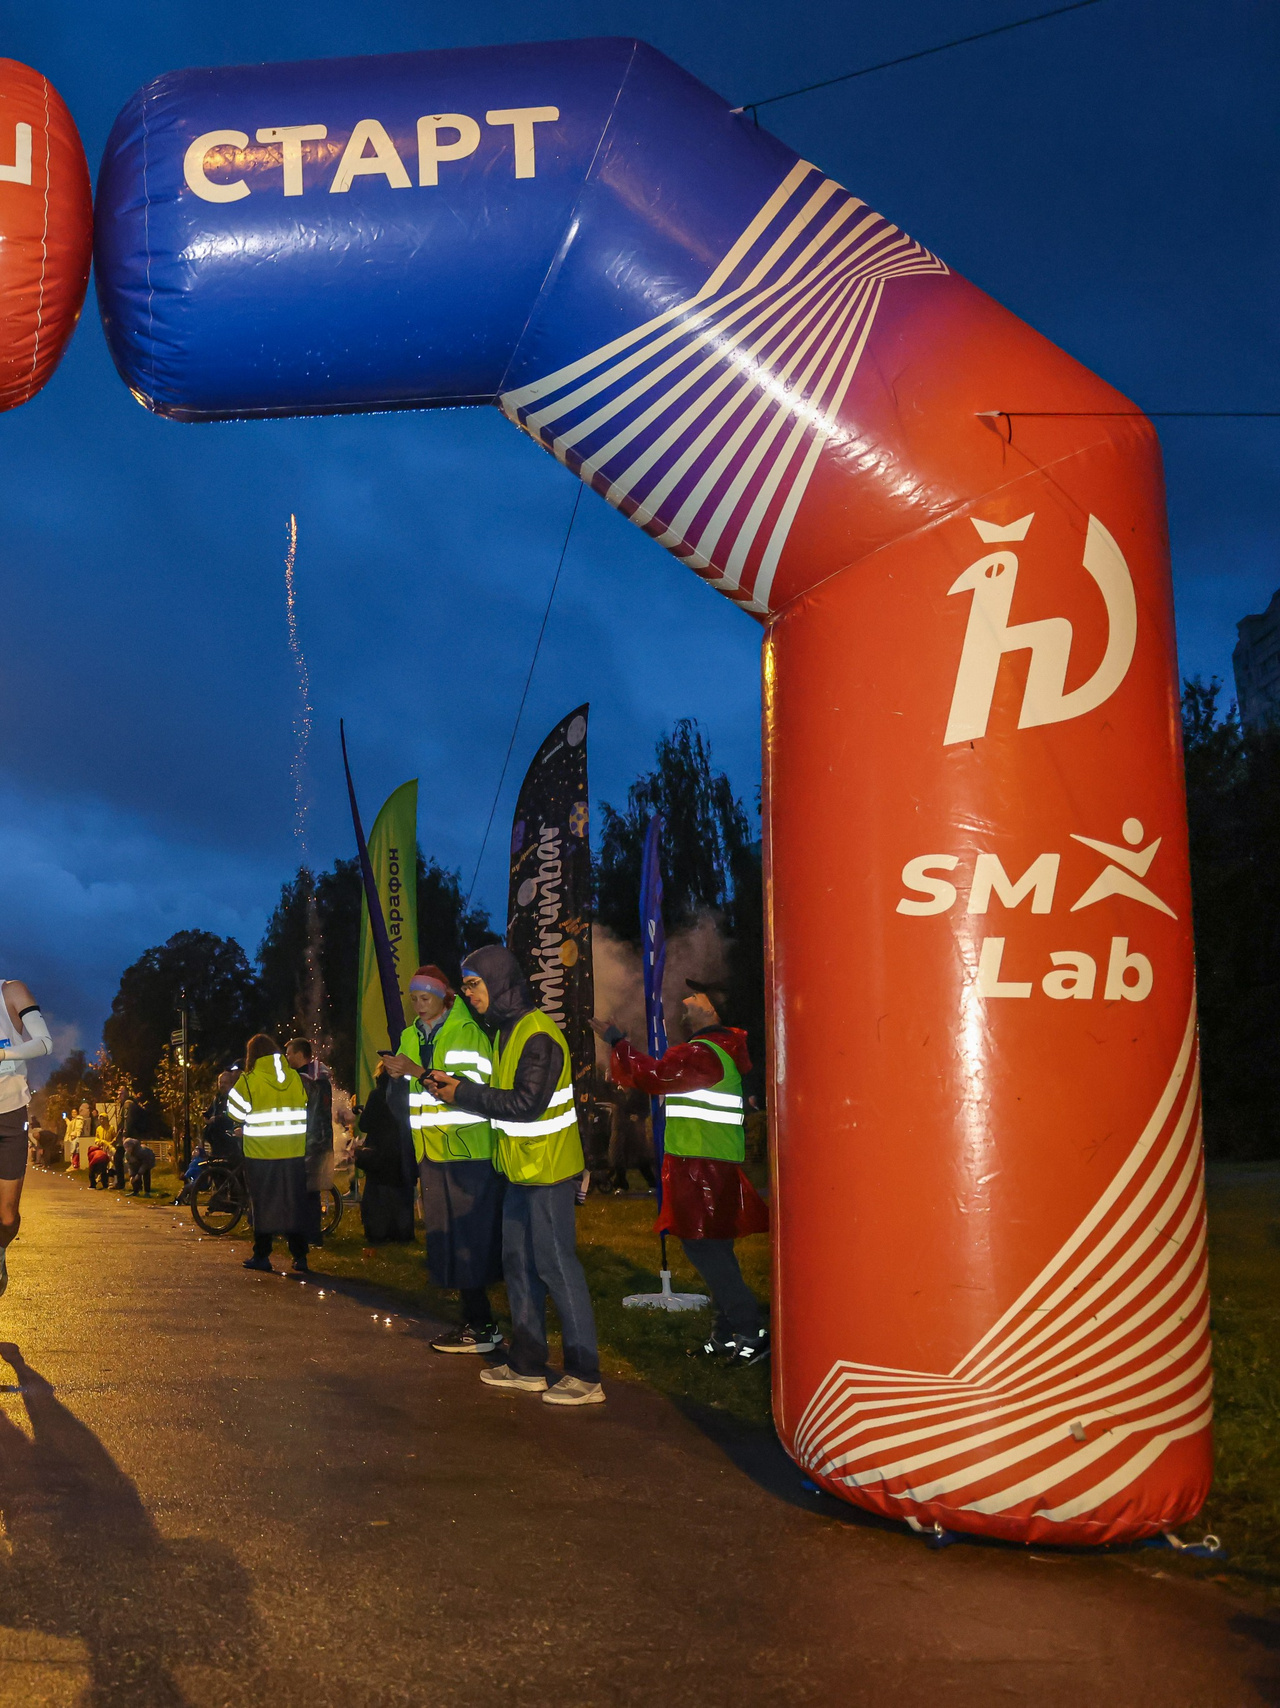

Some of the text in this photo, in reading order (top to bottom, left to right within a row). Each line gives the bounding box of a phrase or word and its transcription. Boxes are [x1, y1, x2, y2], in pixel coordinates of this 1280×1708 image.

[183, 106, 559, 204] СТАРТ
[896, 853, 1060, 915] SM
[974, 936, 1153, 1002] Lab
